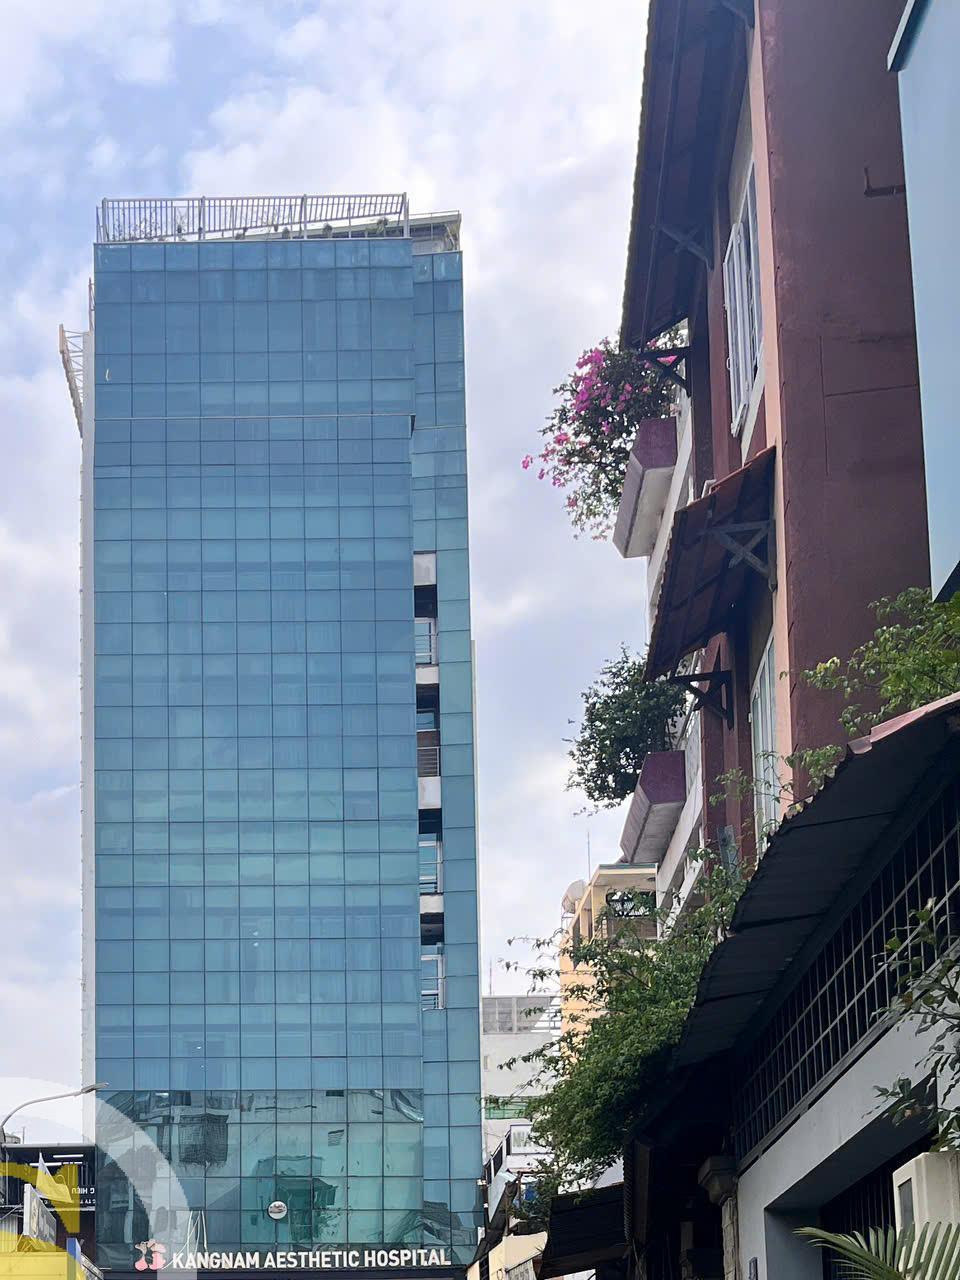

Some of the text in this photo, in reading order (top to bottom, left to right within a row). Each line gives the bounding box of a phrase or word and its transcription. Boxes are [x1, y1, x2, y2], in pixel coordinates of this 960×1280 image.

[172, 1249, 452, 1269] KANGNAM AESTHETIC HOSPITAL
